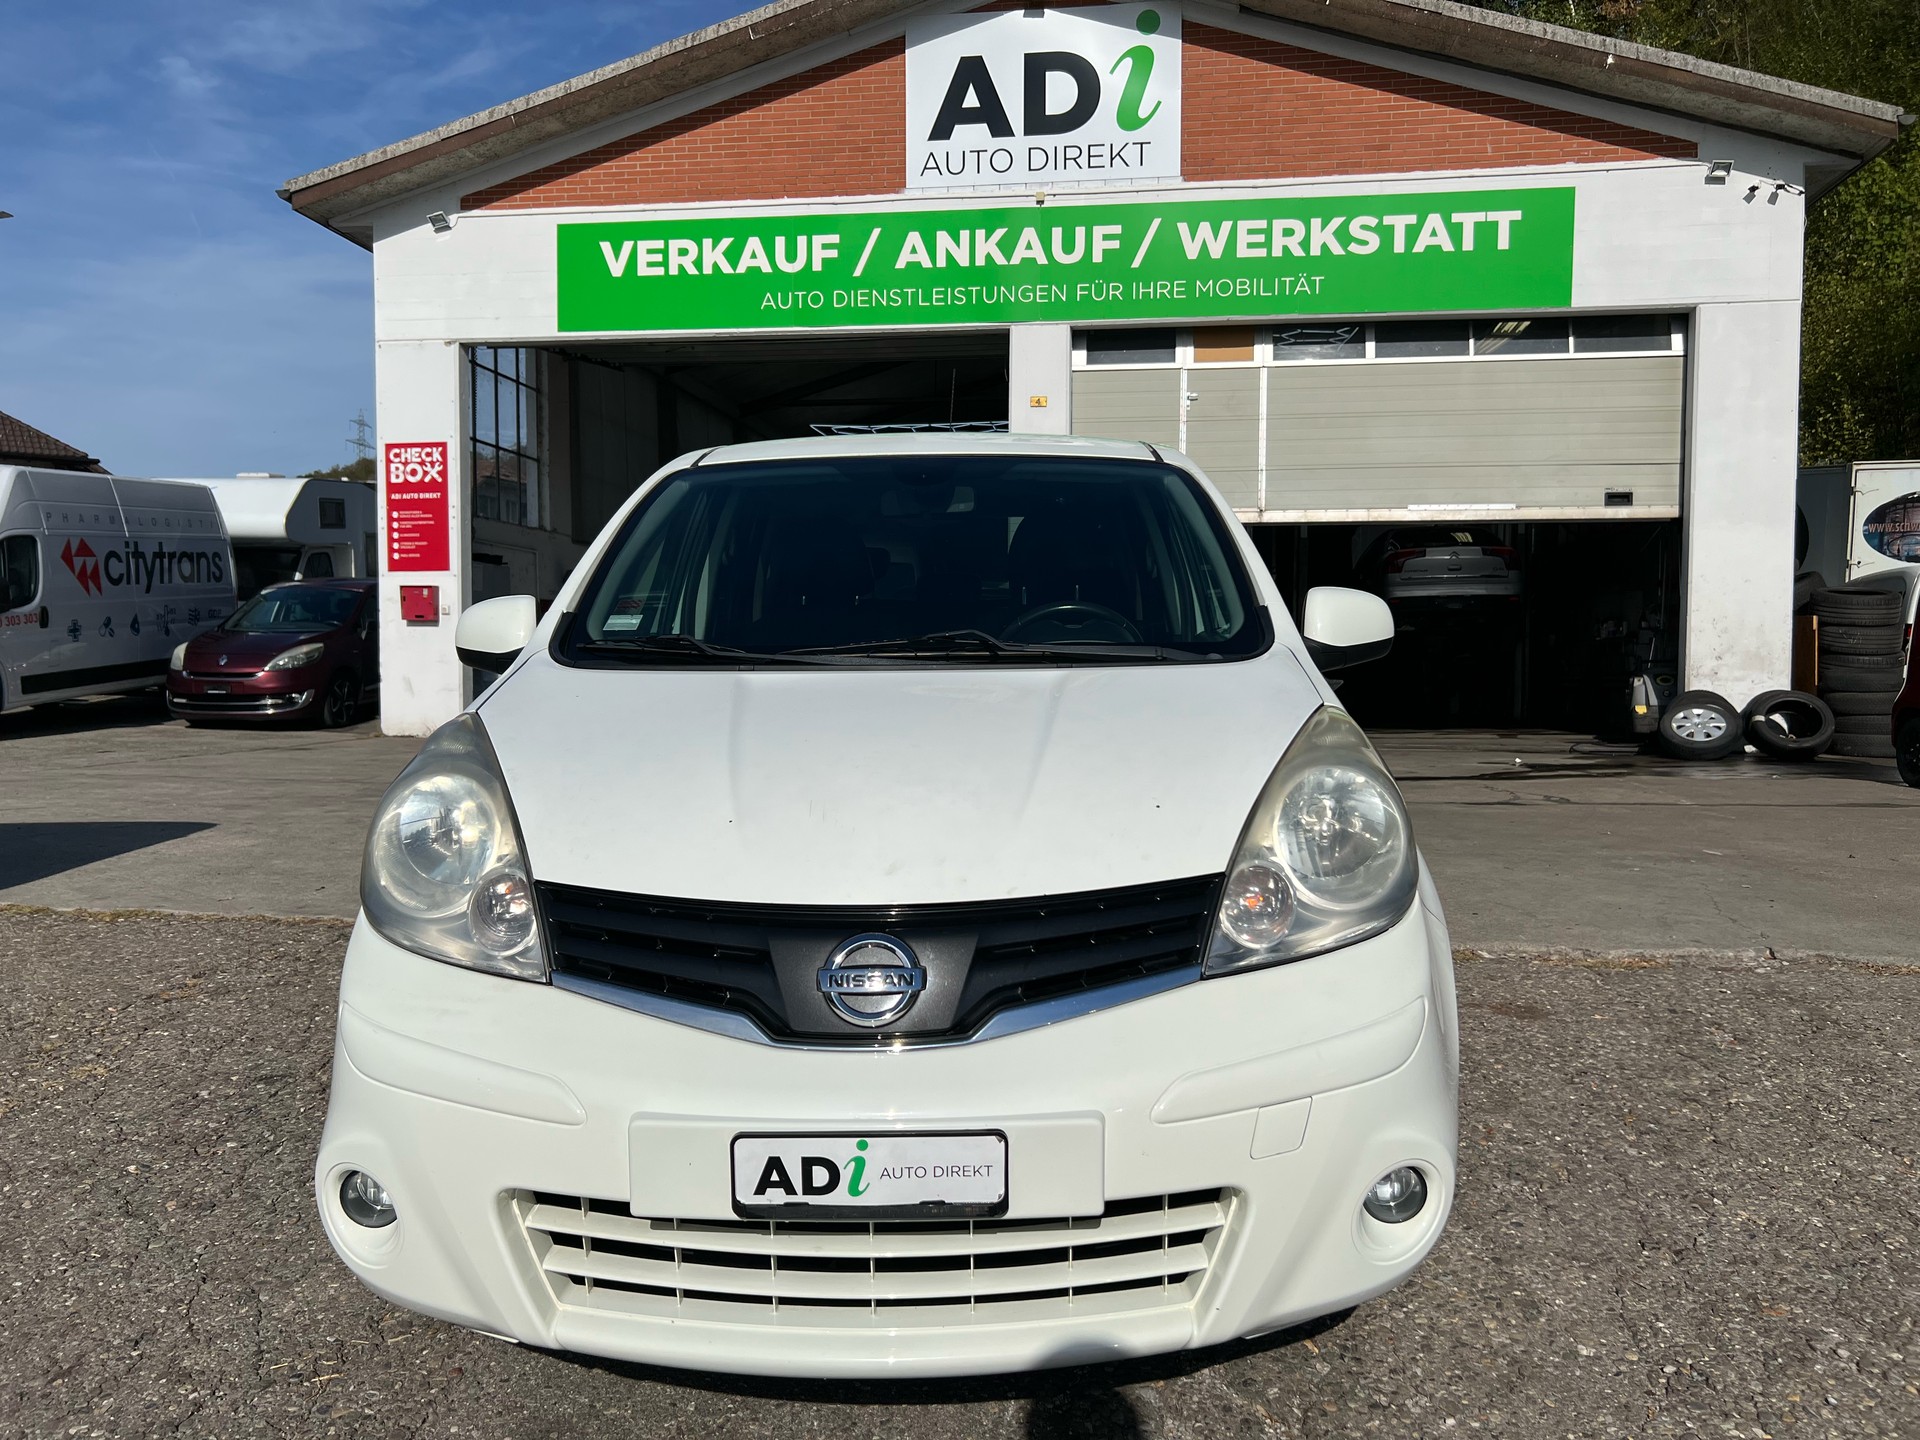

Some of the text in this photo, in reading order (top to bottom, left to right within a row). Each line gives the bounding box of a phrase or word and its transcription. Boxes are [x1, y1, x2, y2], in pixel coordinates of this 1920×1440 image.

[920, 141, 1152, 176] AUTO DIREKT
[599, 210, 1523, 277] VERKAUF / ANKAUF / WERKSTATT
[760, 273, 1326, 310] AUTO DIENSTLEISTUNGEN FÜR IHRE MOBILITÄT
[389, 447, 443, 463] CHECK
[390, 462, 444, 484] BOX
[104, 541, 223, 594] citytrans
[5, 615, 21, 627] 303
[23, 612, 38, 625] 303
[827, 971, 916, 988] NISSAN
[753, 1139, 994, 1197] ADi AUTO DIREKT
